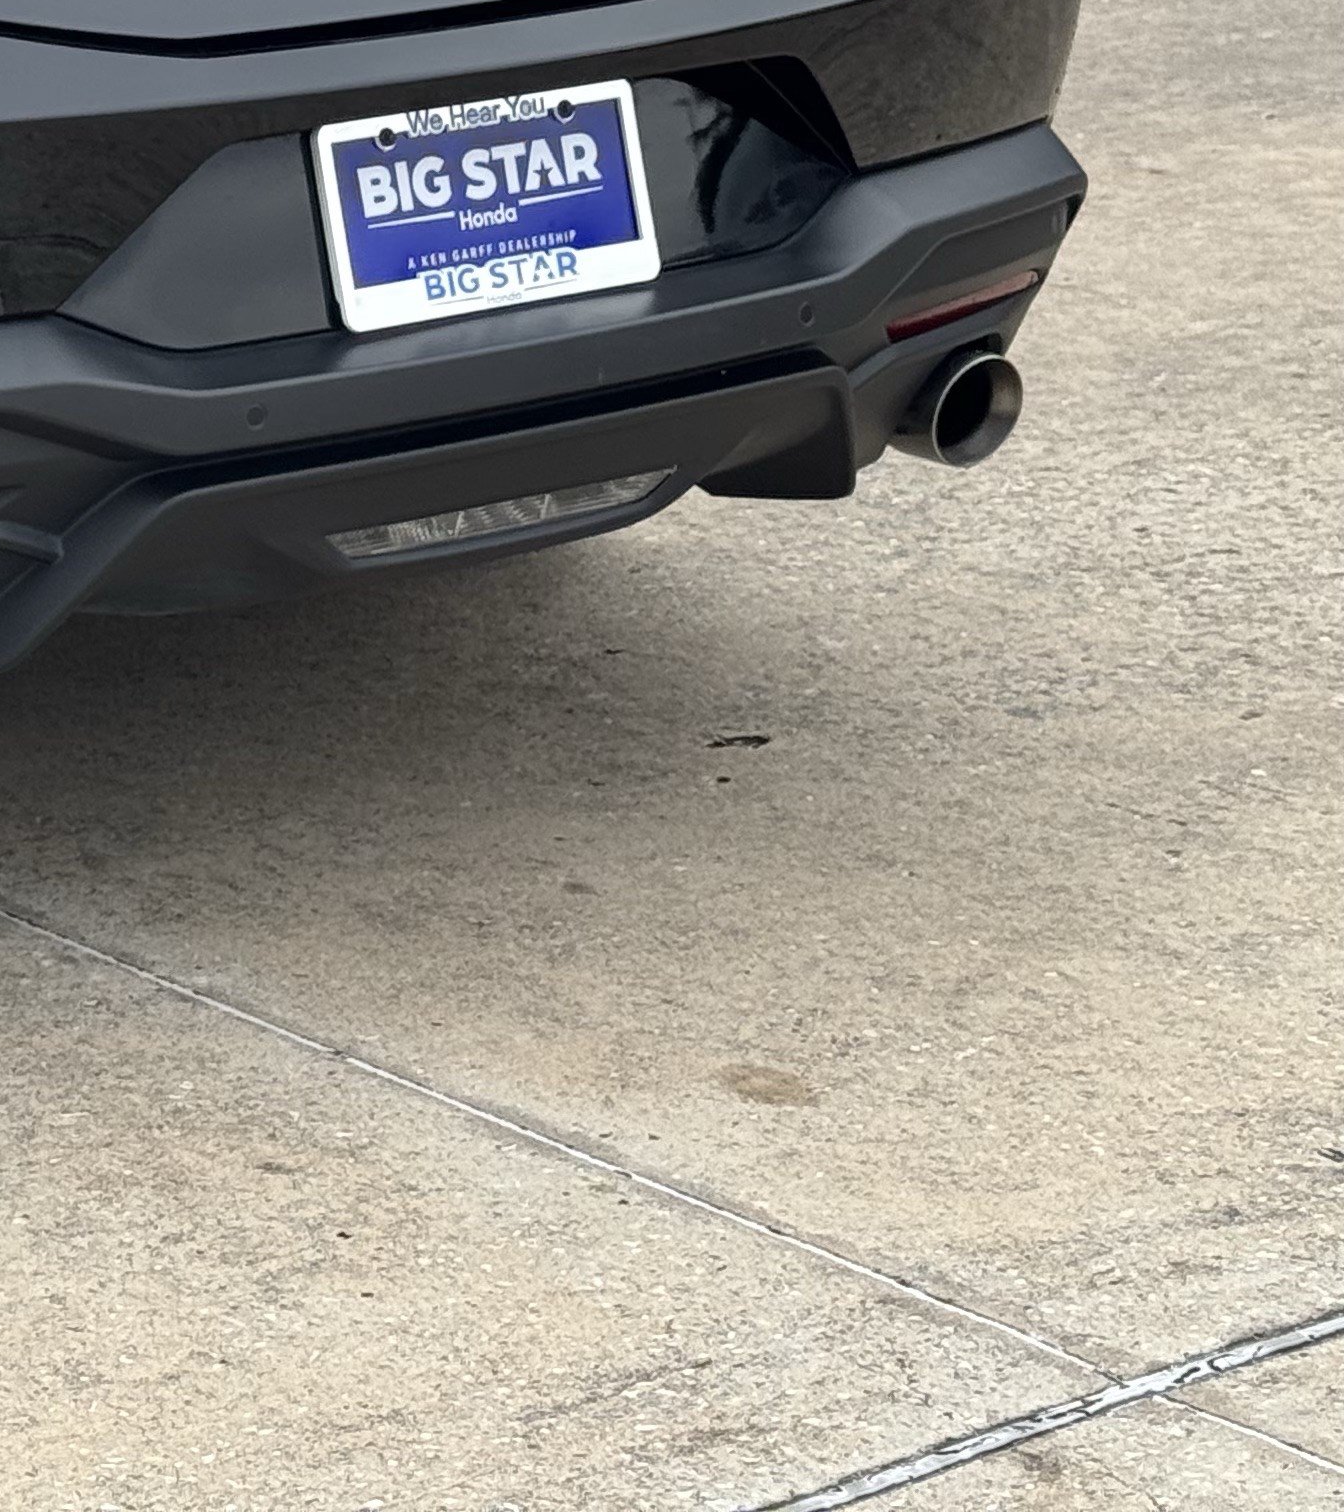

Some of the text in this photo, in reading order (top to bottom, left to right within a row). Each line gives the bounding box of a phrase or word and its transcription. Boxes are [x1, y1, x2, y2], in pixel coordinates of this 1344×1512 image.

[406, 96, 546, 135] We Hear You
[356, 132, 602, 219] BIG STAR
[458, 202, 519, 232] Honda
[407, 229, 578, 270] A KEN GARFF DEALERSHIP
[424, 250, 579, 302] BIG STAR
[486, 291, 523, 305] Honda
